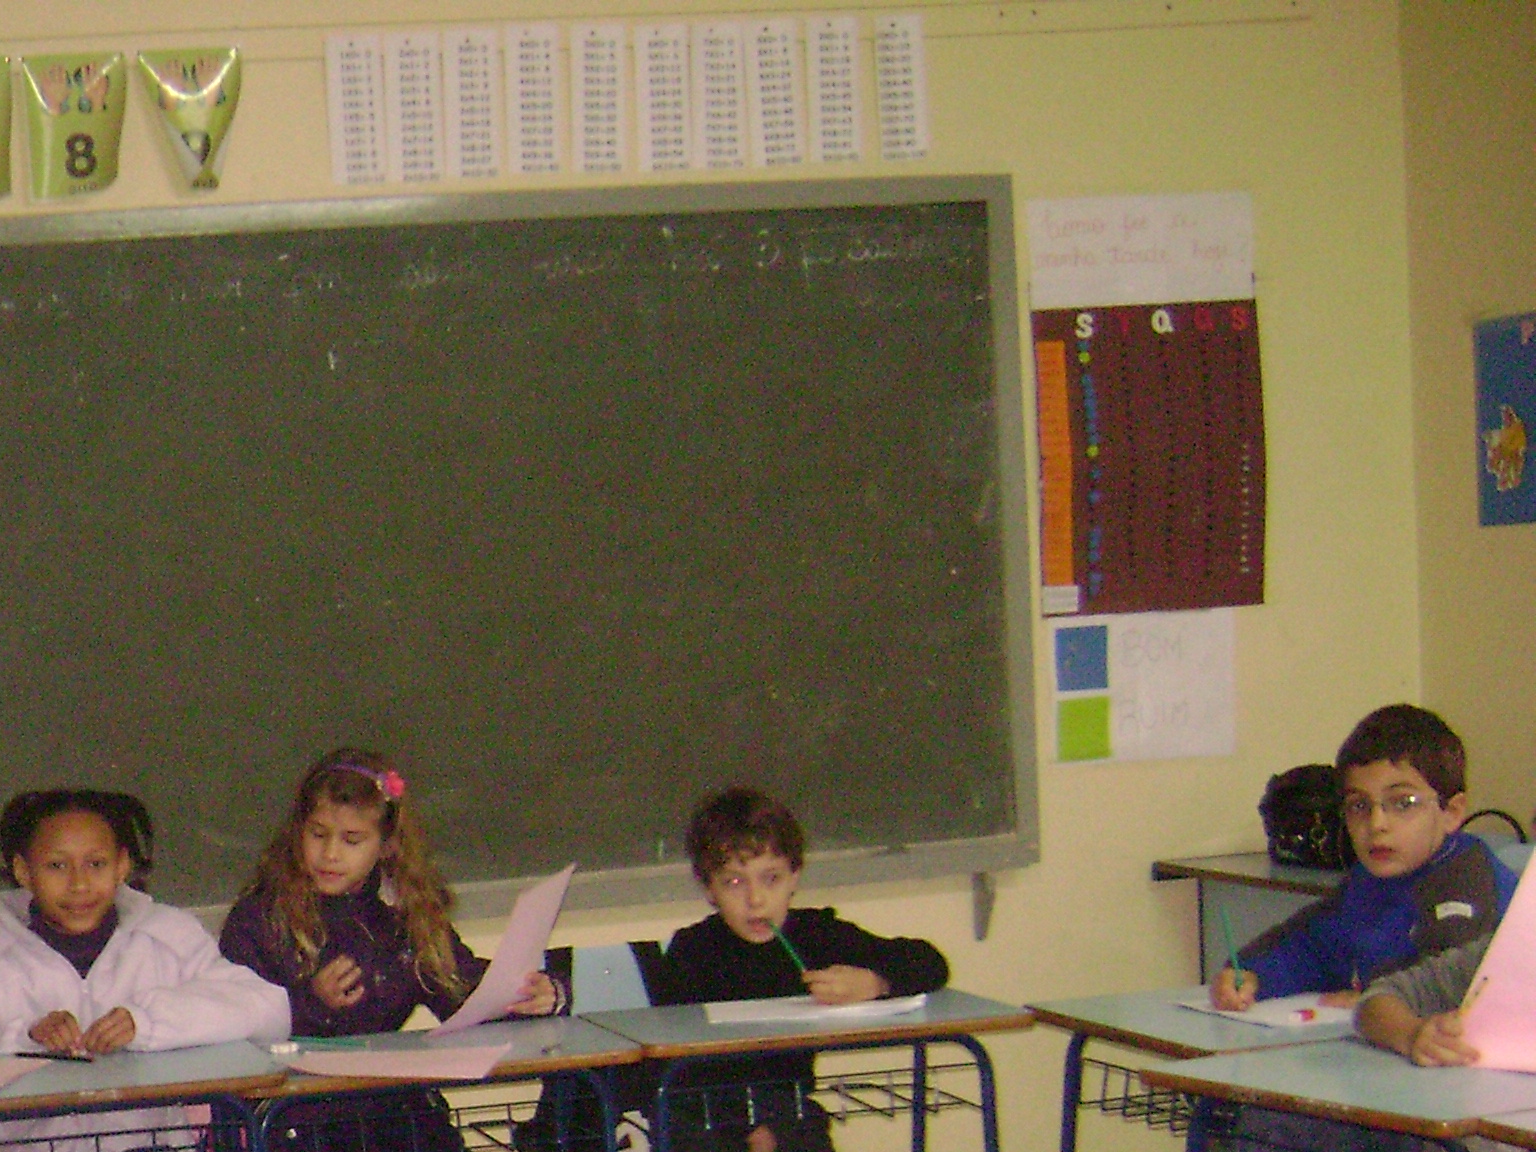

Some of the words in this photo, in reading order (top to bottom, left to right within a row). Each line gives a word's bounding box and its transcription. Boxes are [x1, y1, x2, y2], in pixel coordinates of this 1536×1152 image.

[65, 133, 97, 178] 8
[1075, 312, 1094, 338] S
[1230, 305, 1248, 331] S
